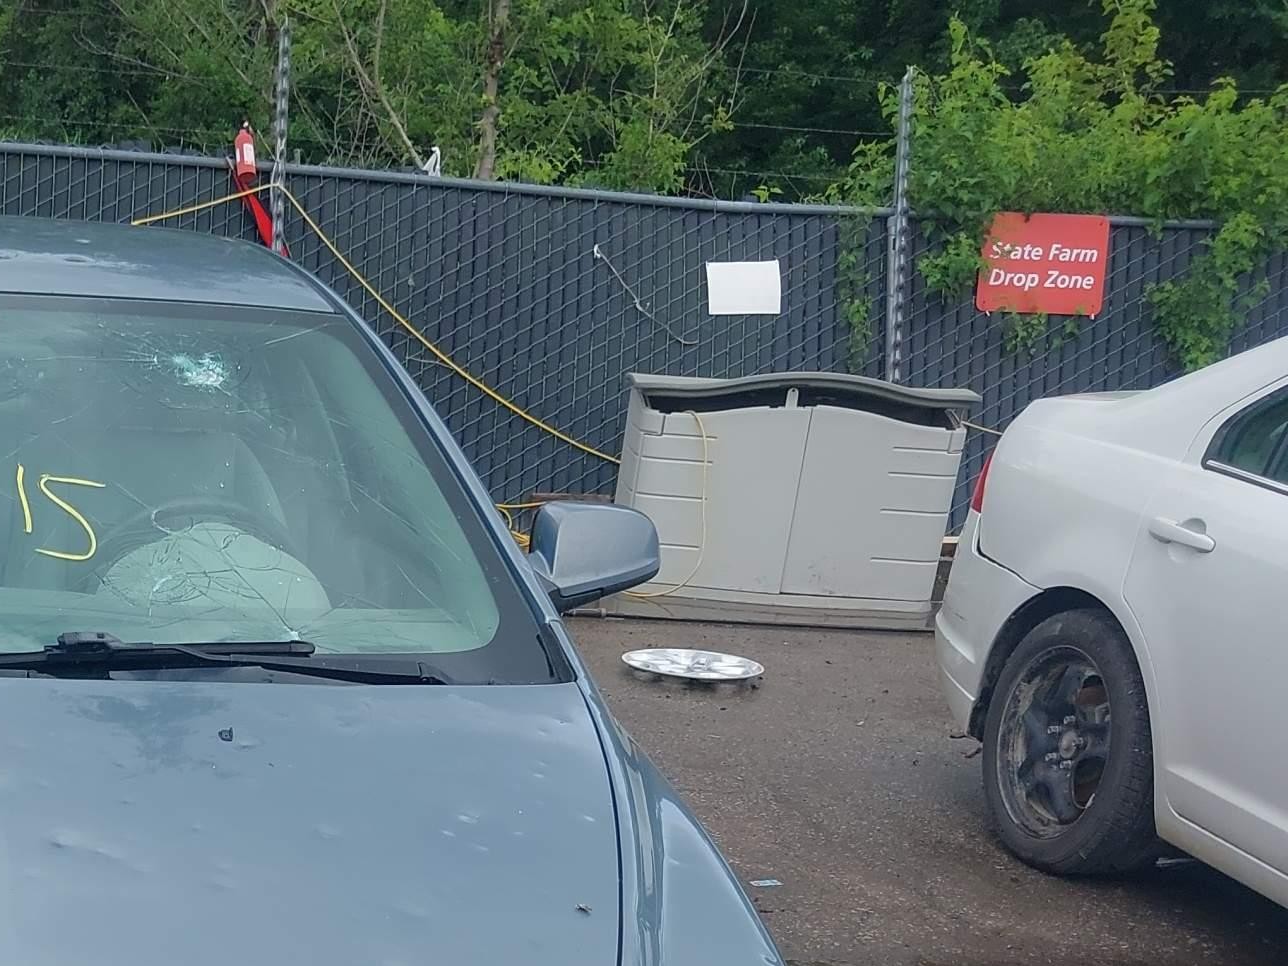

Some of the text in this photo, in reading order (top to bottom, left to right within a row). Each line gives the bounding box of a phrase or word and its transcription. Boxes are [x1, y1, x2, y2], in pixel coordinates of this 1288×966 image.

[1048, 244, 1098, 263] Farm
[988, 268, 1094, 292] Drop Zone
